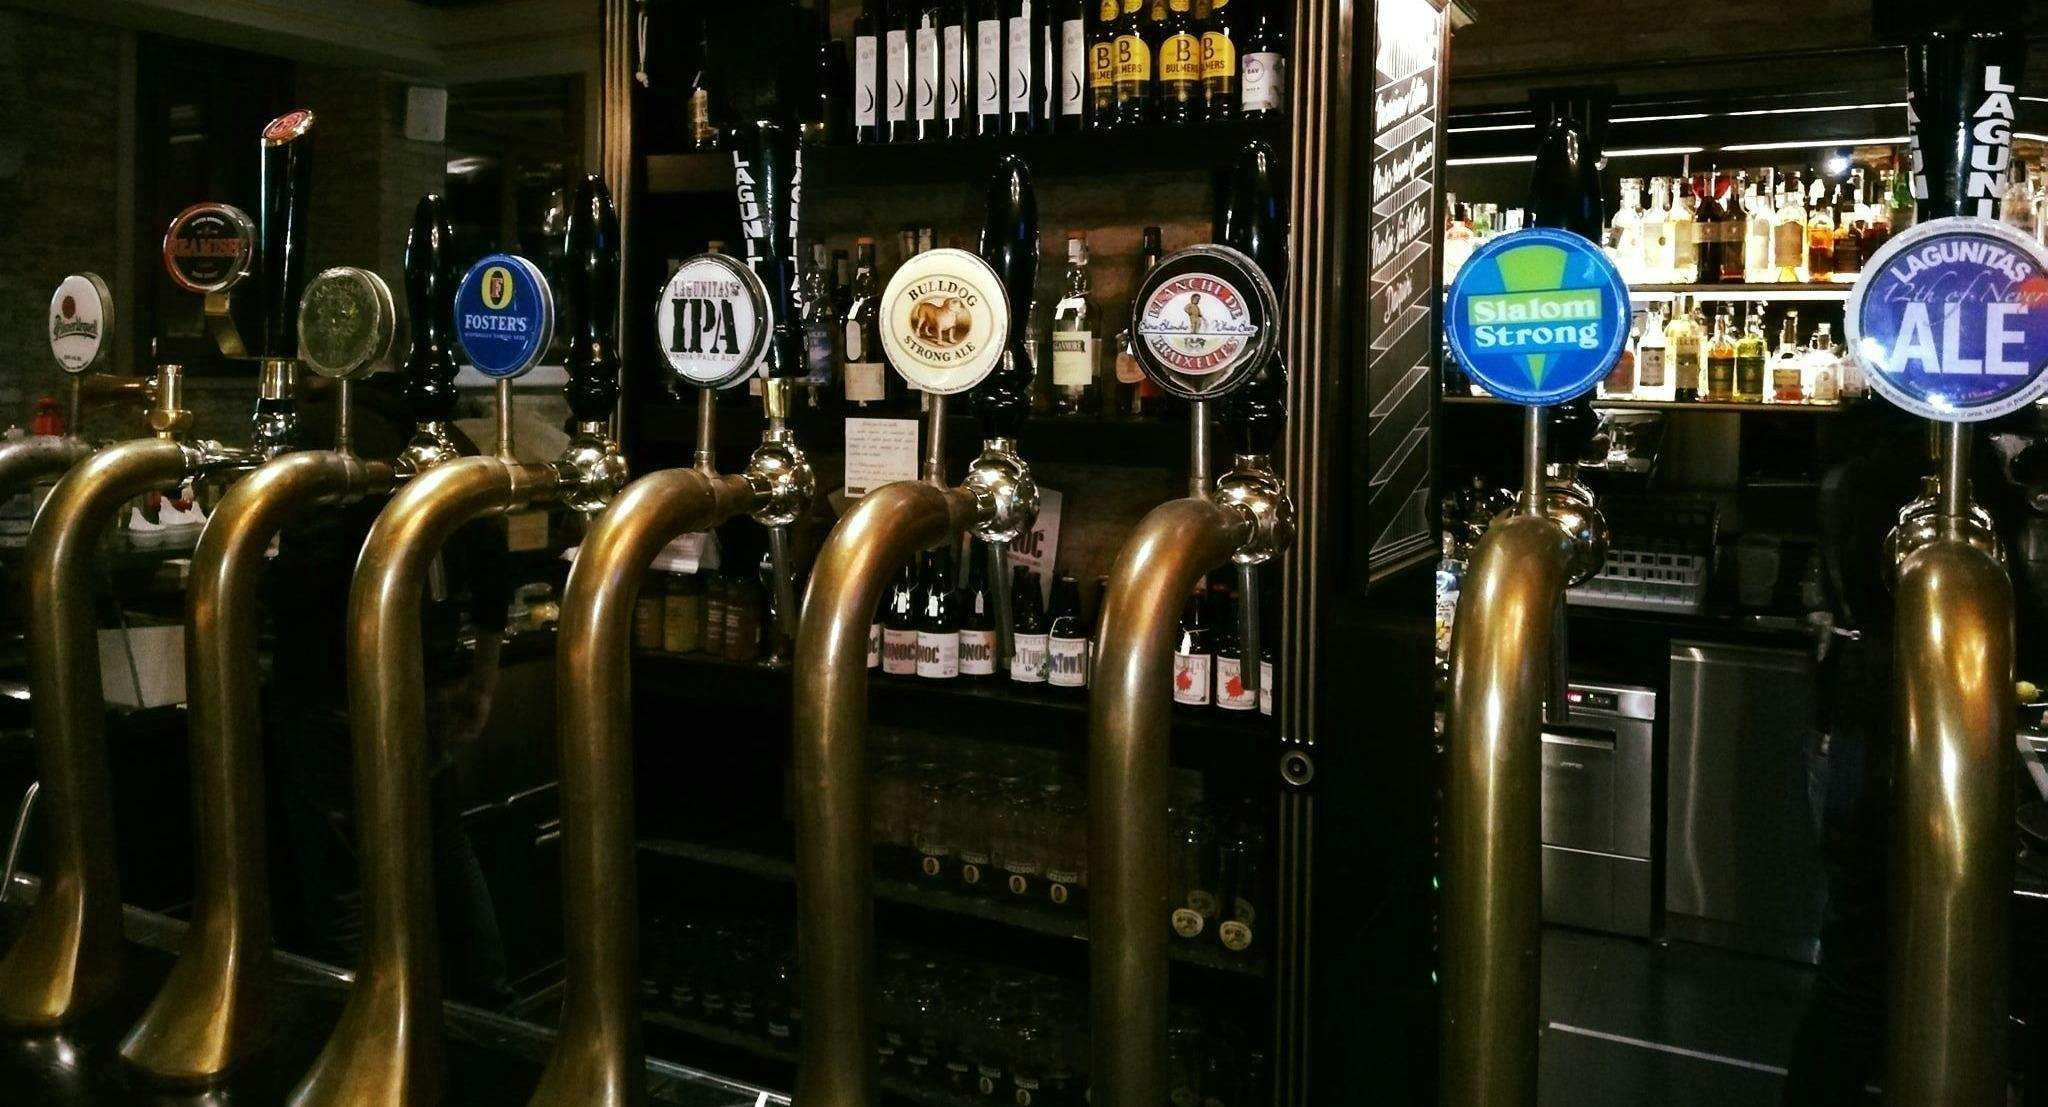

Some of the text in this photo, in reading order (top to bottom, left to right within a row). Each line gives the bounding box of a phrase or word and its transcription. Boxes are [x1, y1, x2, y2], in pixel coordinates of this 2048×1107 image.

[1890, 241, 2032, 285] LAGUNITAS
[673, 280, 730, 298] LAGUNITAS
[908, 280, 978, 308] BULLDOG
[464, 314, 527, 332] FOSTER'S
[1473, 297, 1597, 324] Slalom
[670, 298, 741, 355] IPA
[1475, 322, 1600, 350] Strong
[1887, 302, 2030, 376] ALE
[903, 335, 976, 362] STRONG ALE
